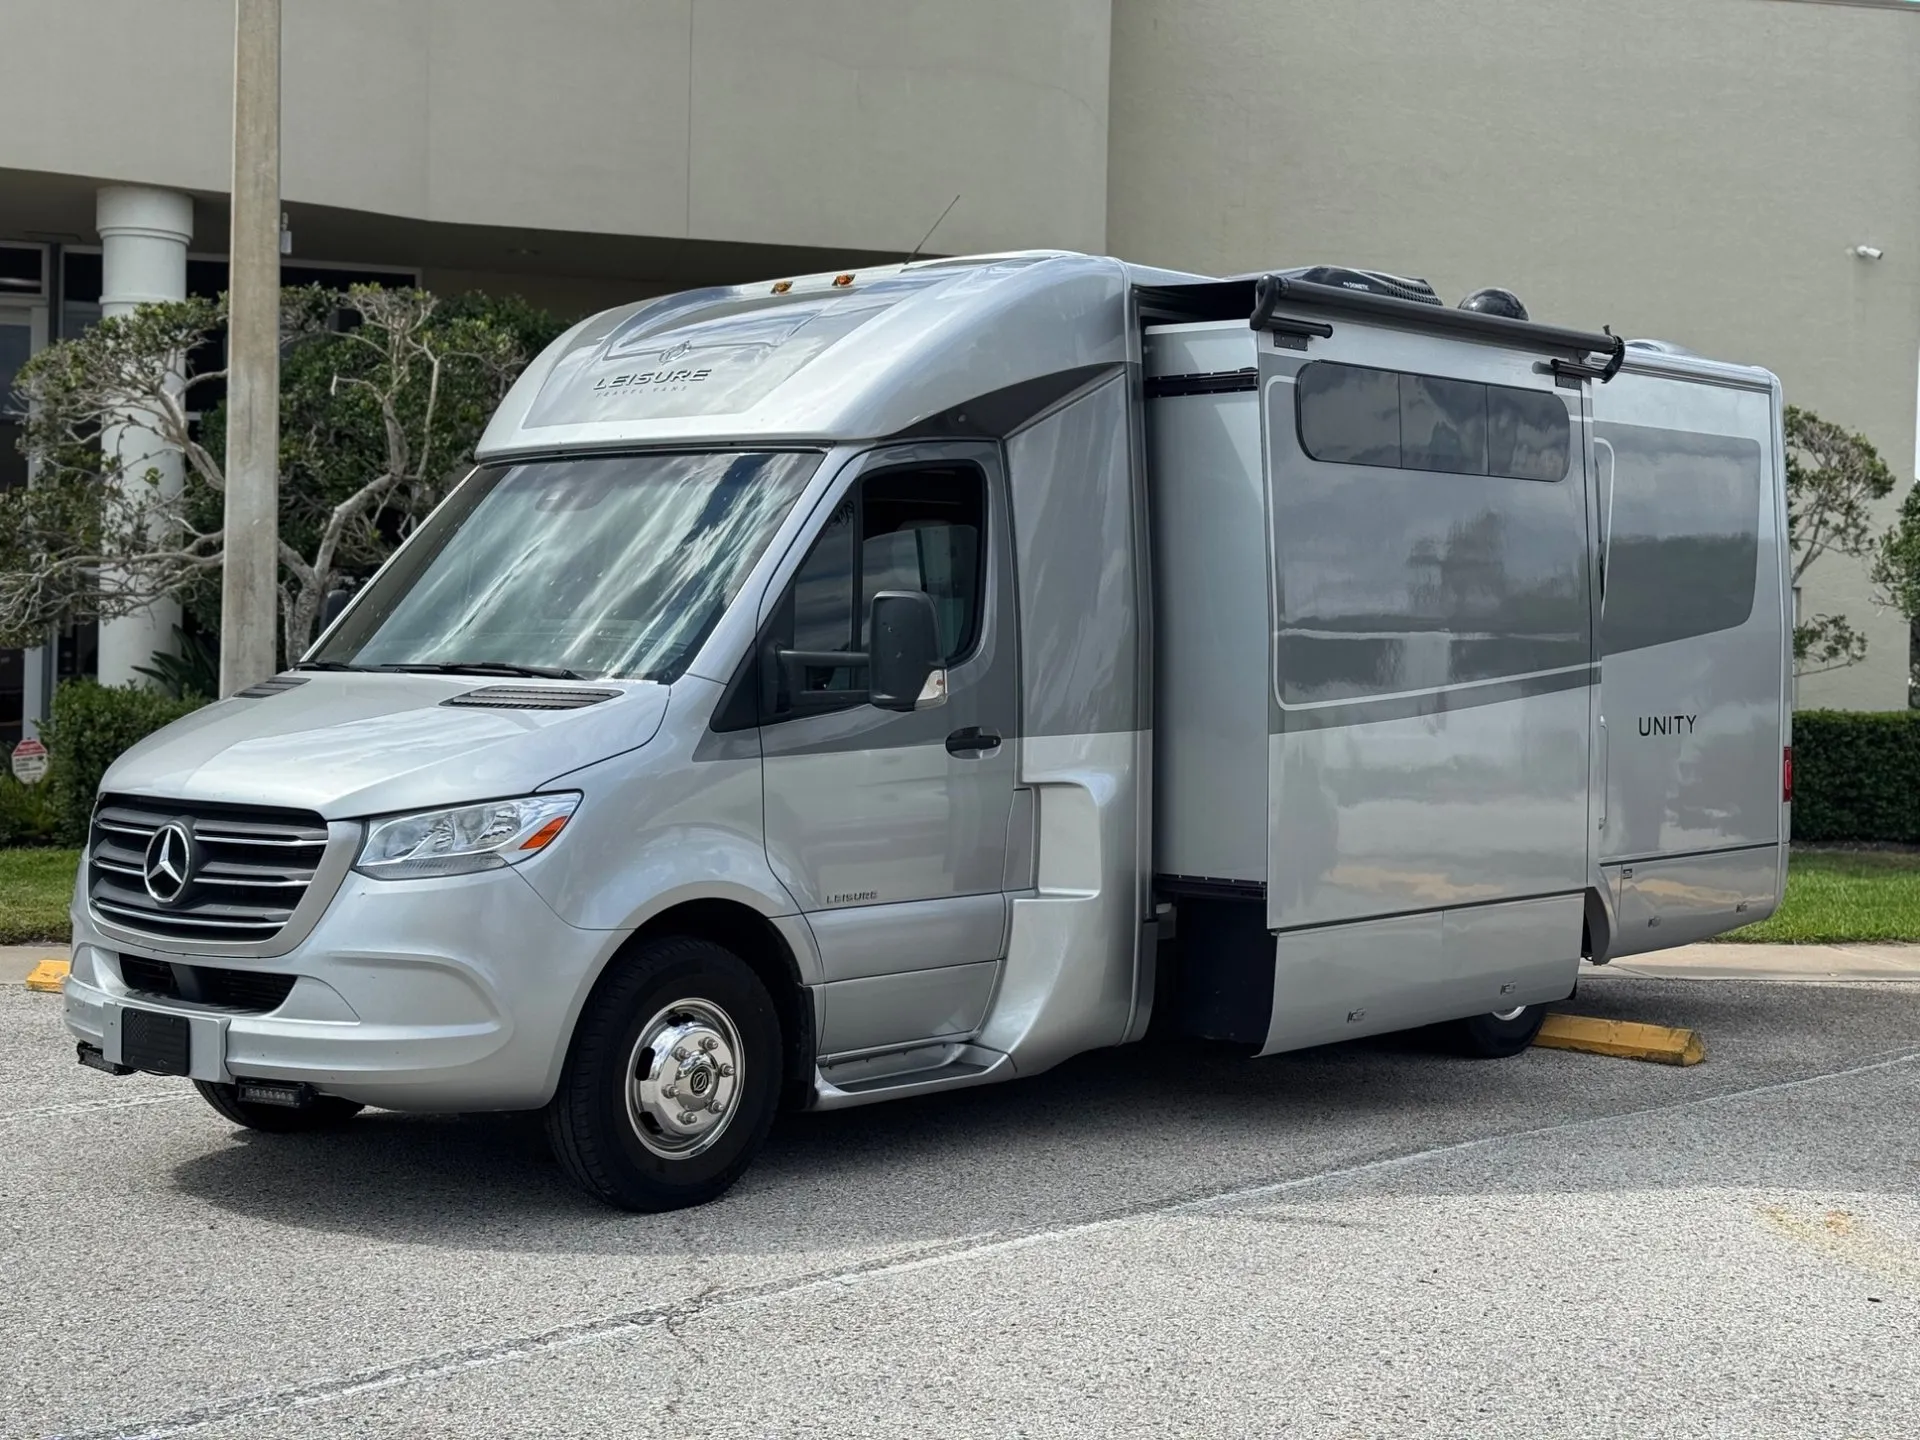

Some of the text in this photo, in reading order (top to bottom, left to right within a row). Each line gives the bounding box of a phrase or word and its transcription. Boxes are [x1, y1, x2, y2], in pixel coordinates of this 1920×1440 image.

[593, 369, 712, 390] LEISURE
[1638, 715, 1697, 736] UNITY
[826, 891, 878, 904] LEISURE
